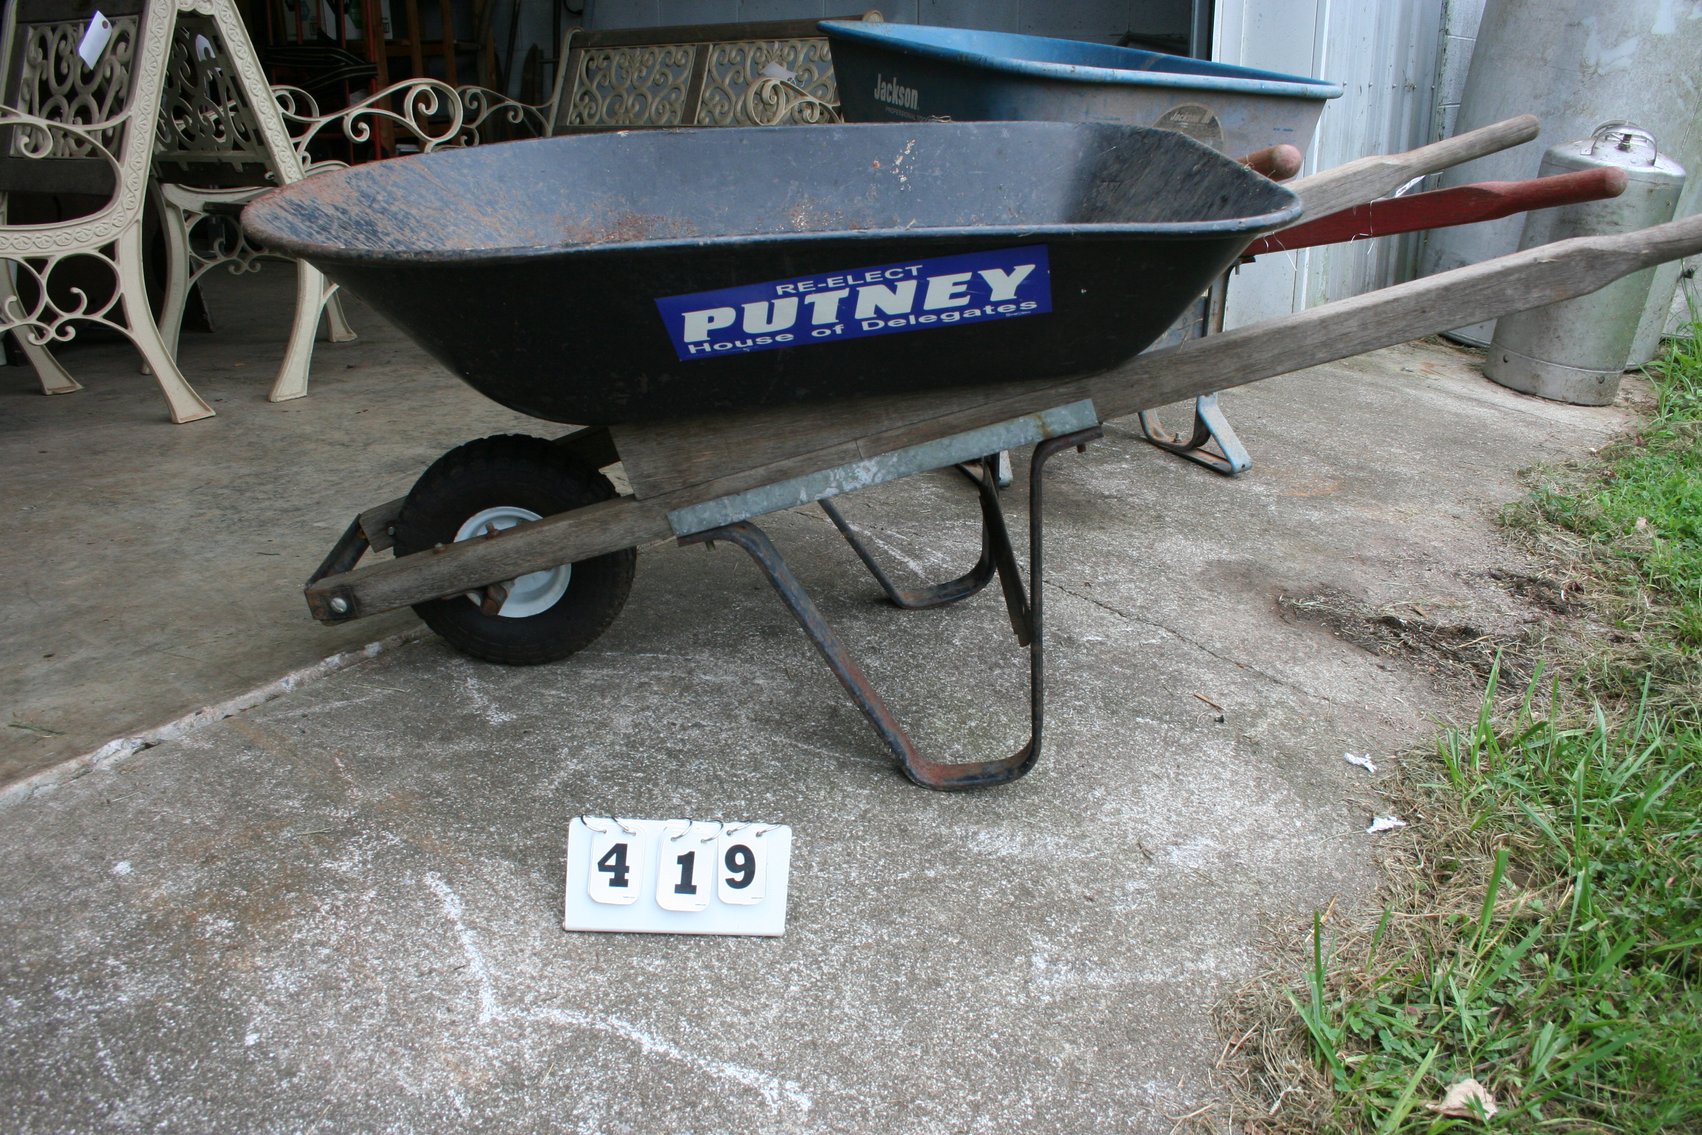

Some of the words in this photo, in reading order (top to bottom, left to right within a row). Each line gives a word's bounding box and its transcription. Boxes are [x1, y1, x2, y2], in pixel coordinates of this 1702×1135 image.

[873, 72, 920, 111] Jackson
[681, 263, 1037, 343] PUTNEY
[775, 264, 924, 296] RE-ELECT
[687, 333, 795, 355] House
[811, 323, 846, 338] of
[861, 301, 1039, 332] Delegates
